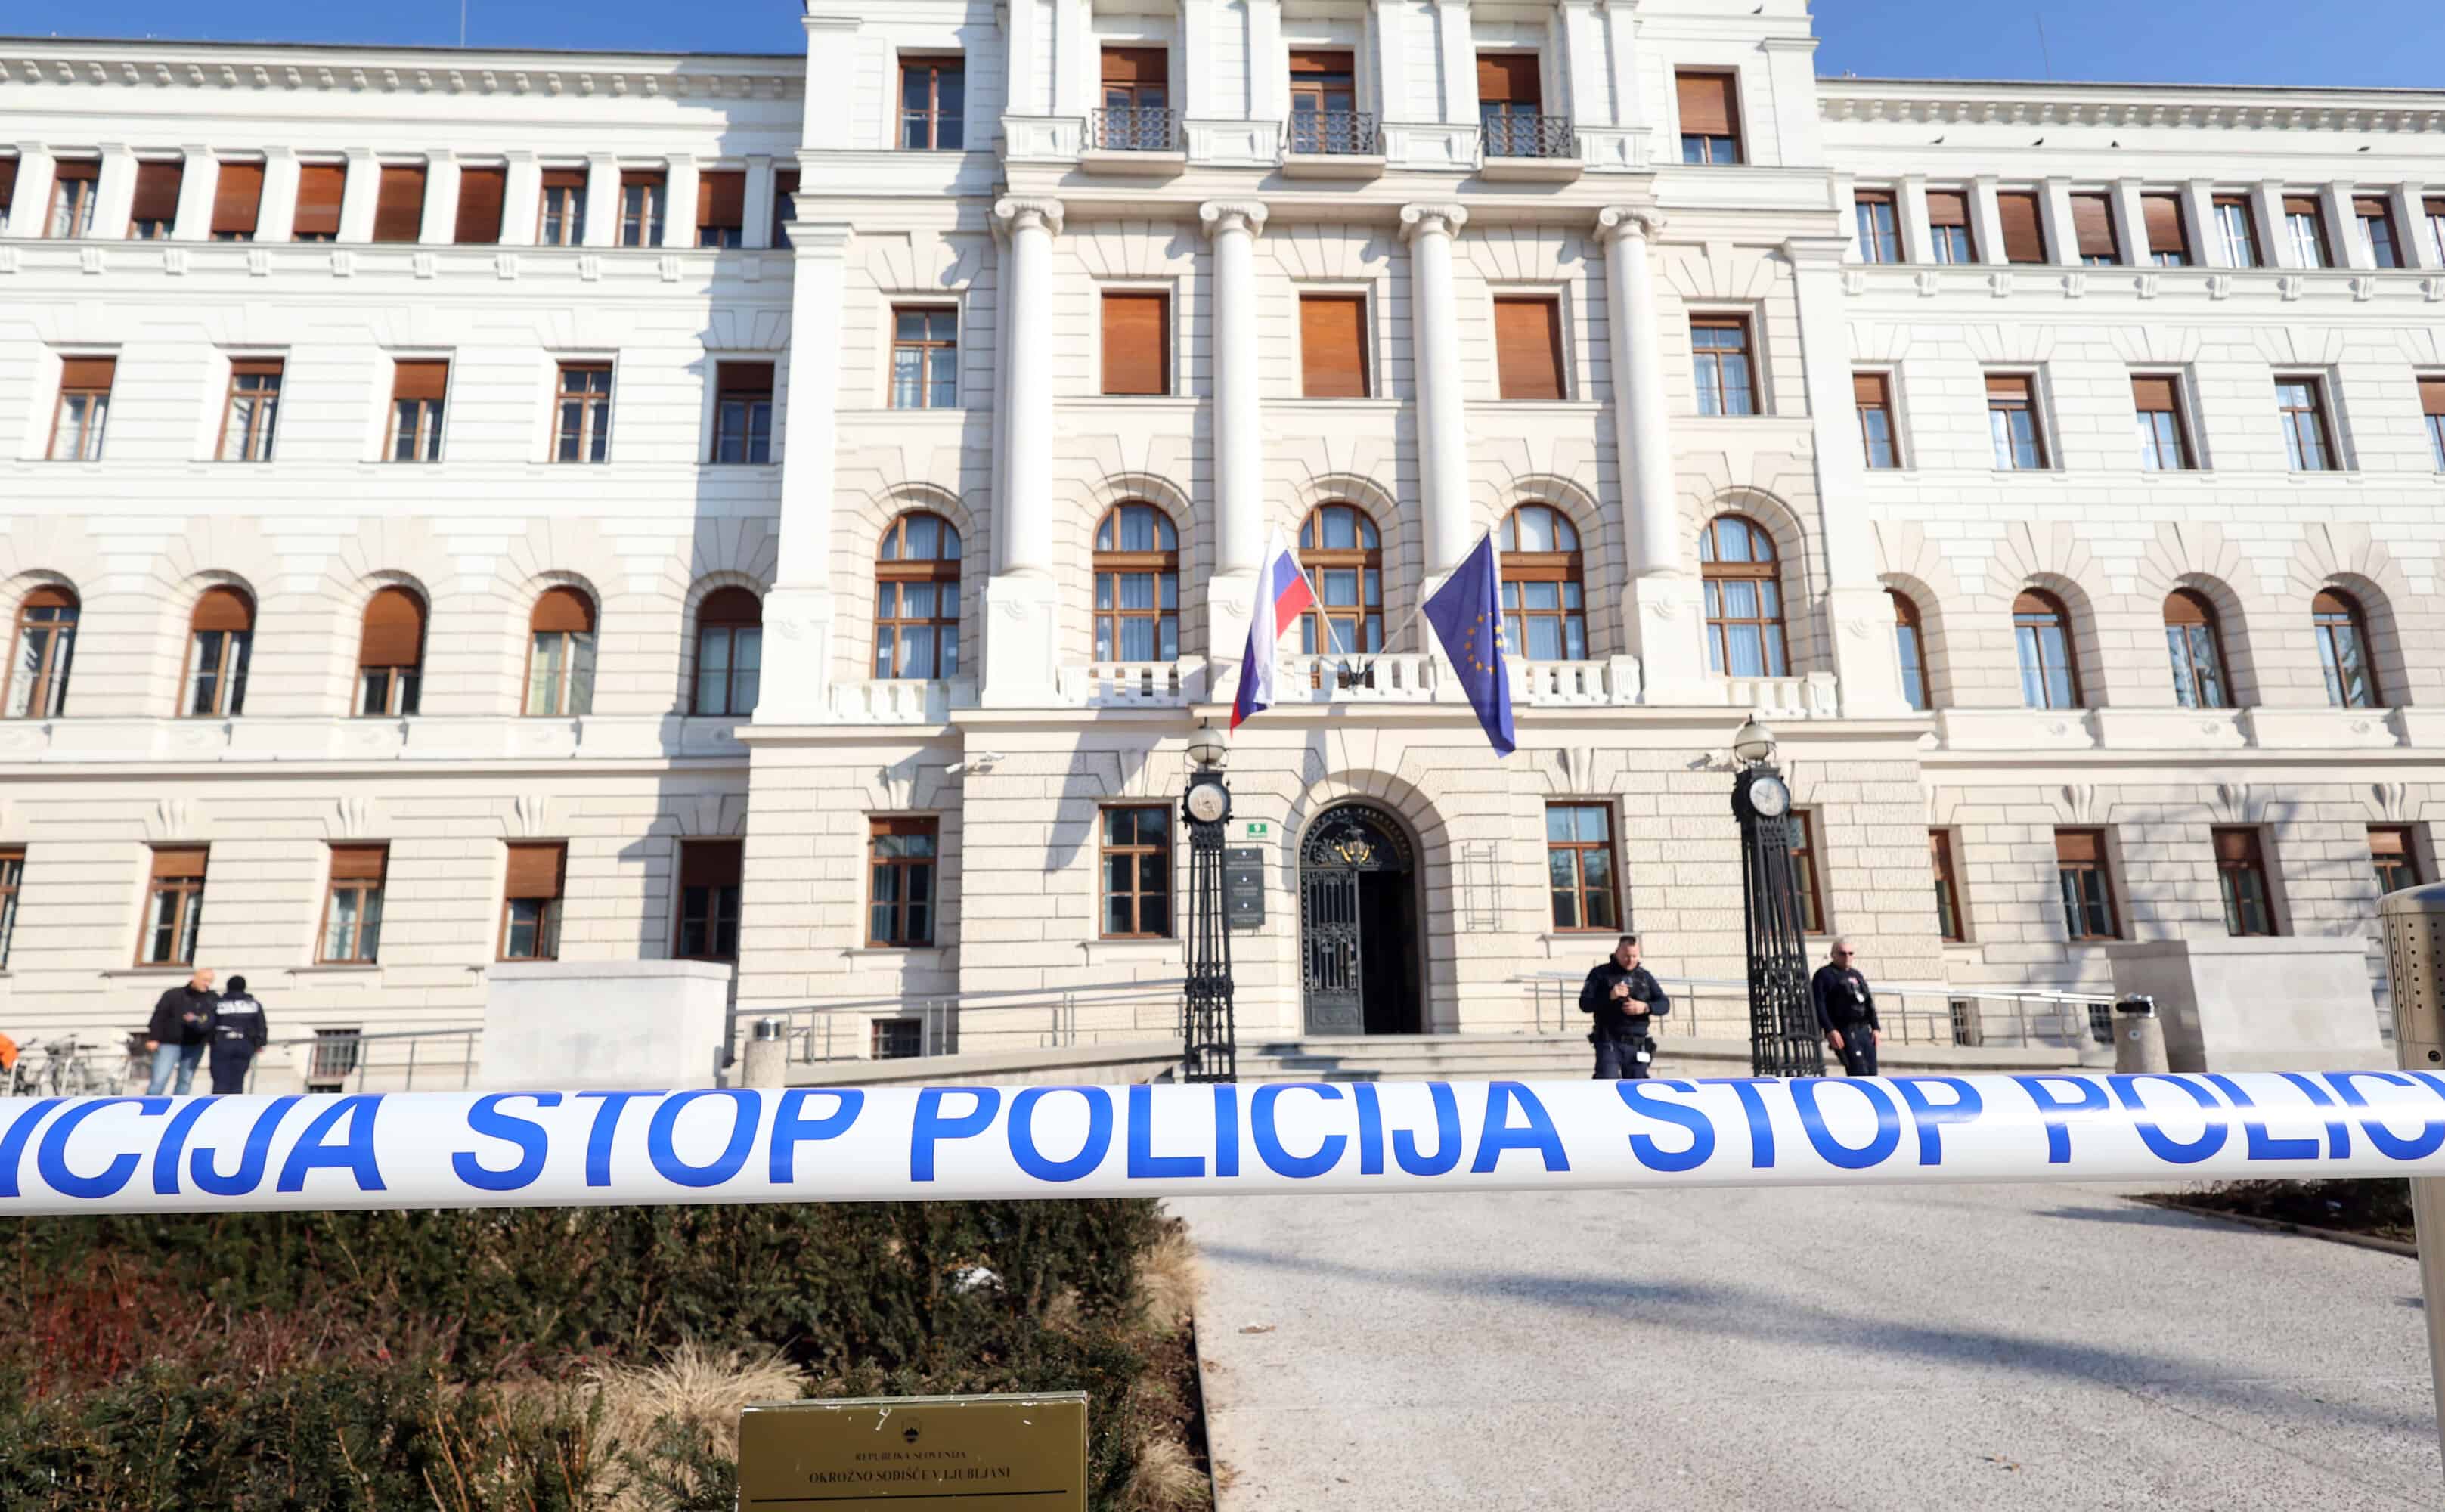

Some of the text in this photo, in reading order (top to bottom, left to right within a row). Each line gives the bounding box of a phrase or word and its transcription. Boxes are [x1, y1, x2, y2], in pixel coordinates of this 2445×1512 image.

[452, 1088, 865, 1191] STOP
[910, 1081, 1570, 1182] POLICIJA
[1616, 1077, 1983, 1172] STOP
[855, 1450, 967, 1461] REPUBLIKA SLOVENIJA
[809, 1468, 873, 1483] OKROŽNO
[876, 1464, 927, 1483] SODIŠČE
[944, 1466, 1011, 1480] LJUBLJANI
